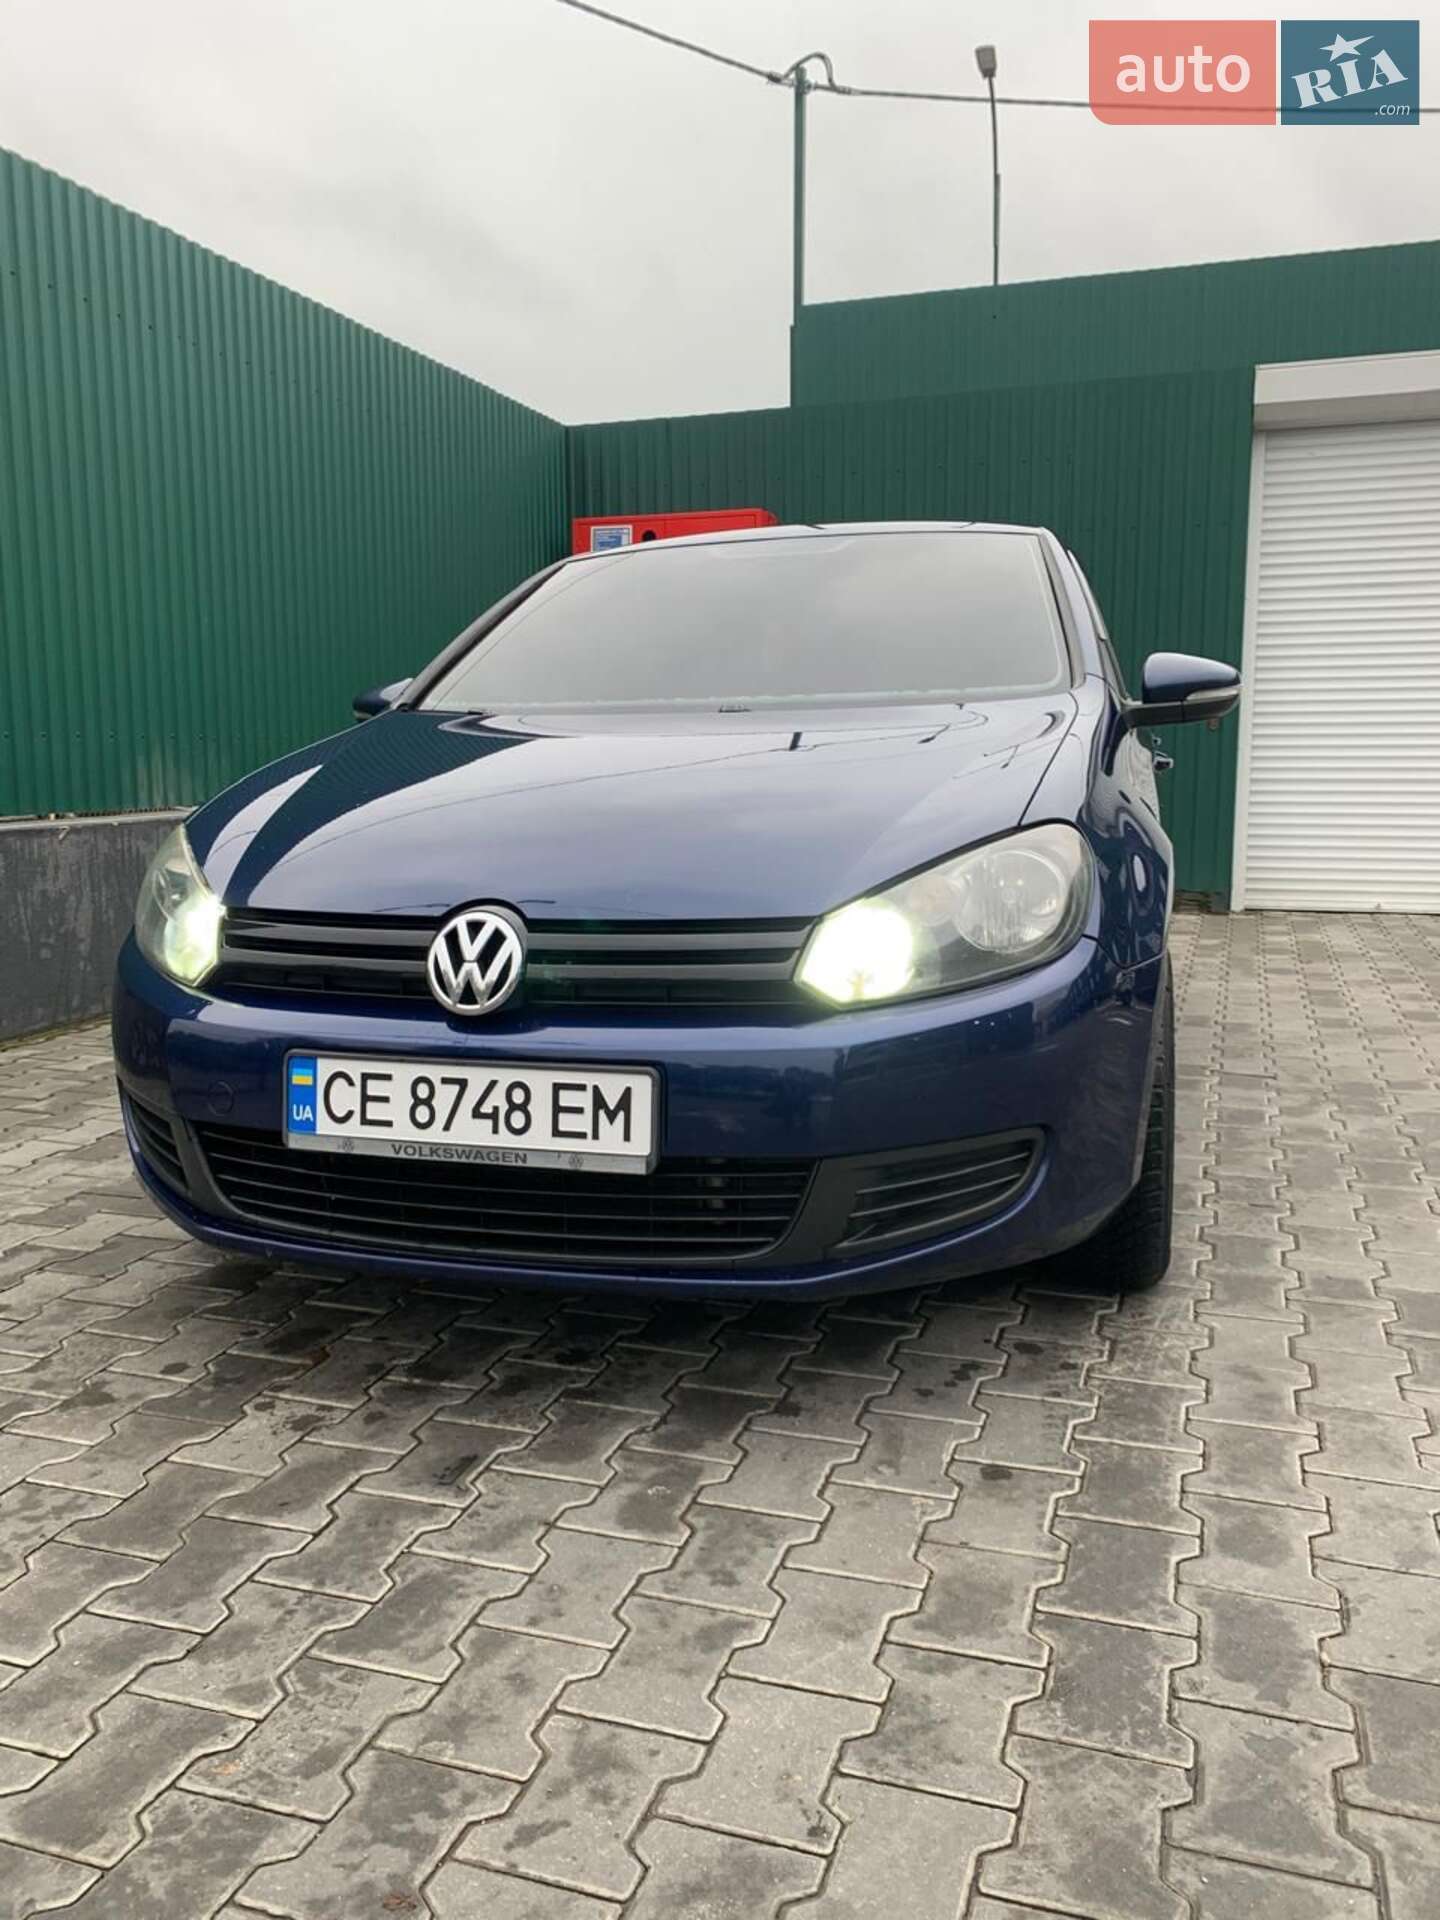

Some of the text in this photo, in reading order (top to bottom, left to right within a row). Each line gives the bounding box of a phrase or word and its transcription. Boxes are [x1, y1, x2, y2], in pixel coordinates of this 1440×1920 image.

[292, 1103, 314, 1122] UA
[323, 1070, 633, 1142] CE 8748 EM
[391, 1143, 528, 1165] VOLKSWAGEN
